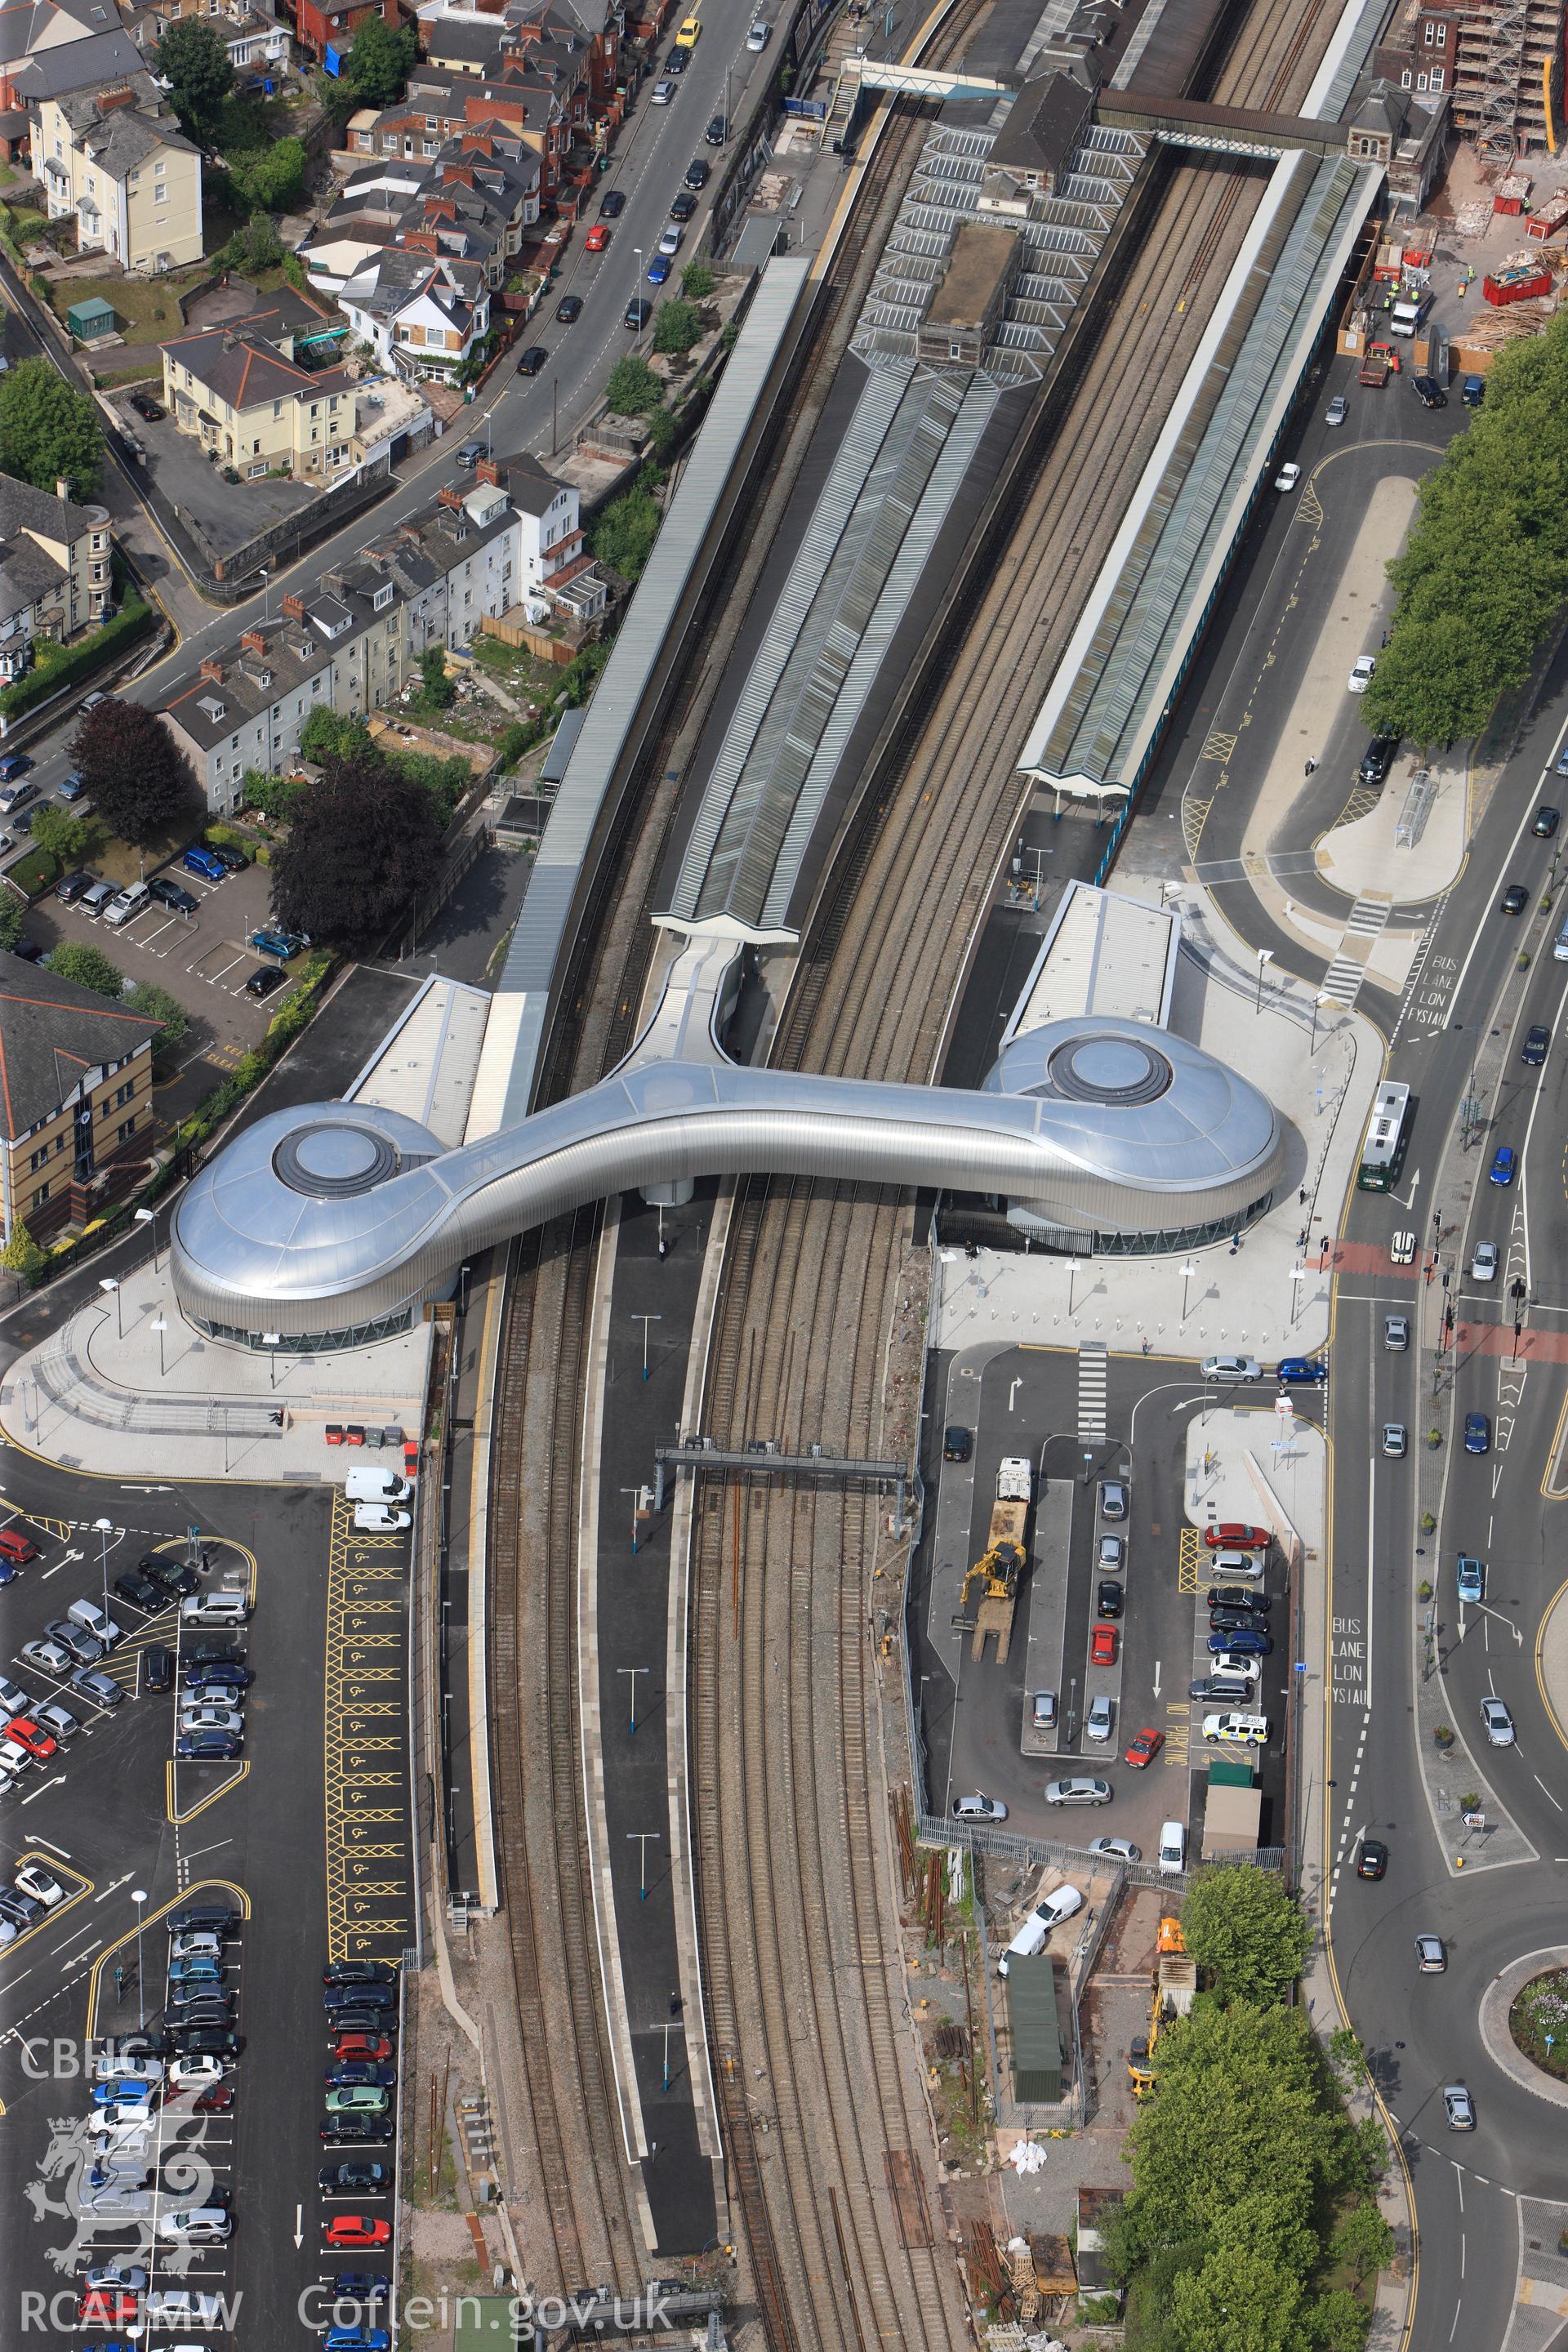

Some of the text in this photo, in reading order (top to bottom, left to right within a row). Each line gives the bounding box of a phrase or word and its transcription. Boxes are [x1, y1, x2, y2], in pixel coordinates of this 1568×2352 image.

[1432, 955, 1459, 971] BUS
[1423, 973, 1456, 990] LANE
[1419, 991, 1446, 1007] LON
[1407, 1007, 1446, 1026] FYSIAU
[1332, 1617, 1361, 1634] BUS
[1331, 1640, 1366, 1659] LANE
[1334, 1664, 1362, 1682] LON
[1164, 1702, 1190, 1766] NO PARKING
